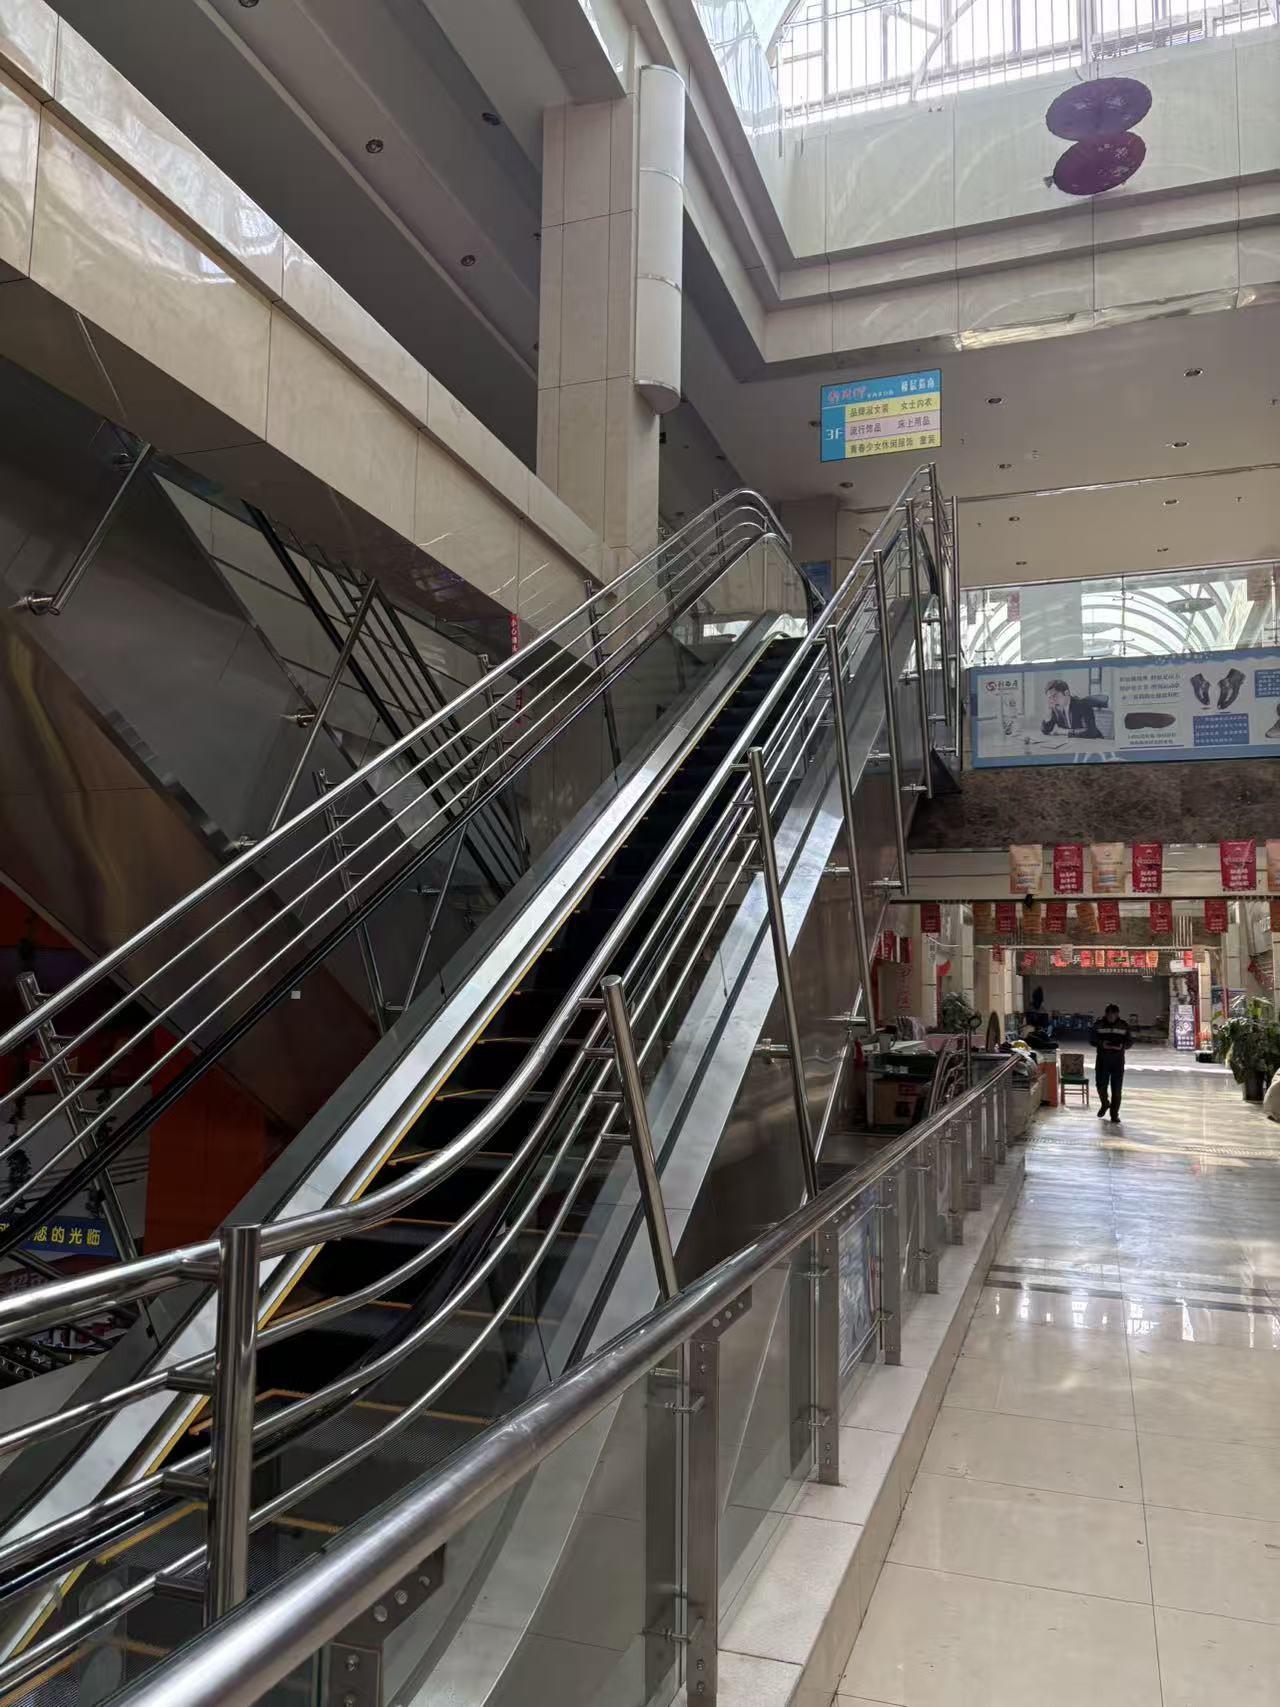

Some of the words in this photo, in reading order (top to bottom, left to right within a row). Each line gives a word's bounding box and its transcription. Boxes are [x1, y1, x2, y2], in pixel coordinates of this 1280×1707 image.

[901, 398, 932, 410] 女士内衣
[850, 423, 881, 436] 流行饰品
[898, 417, 930, 429] 床上用品
[825, 428, 843, 440] 3F
